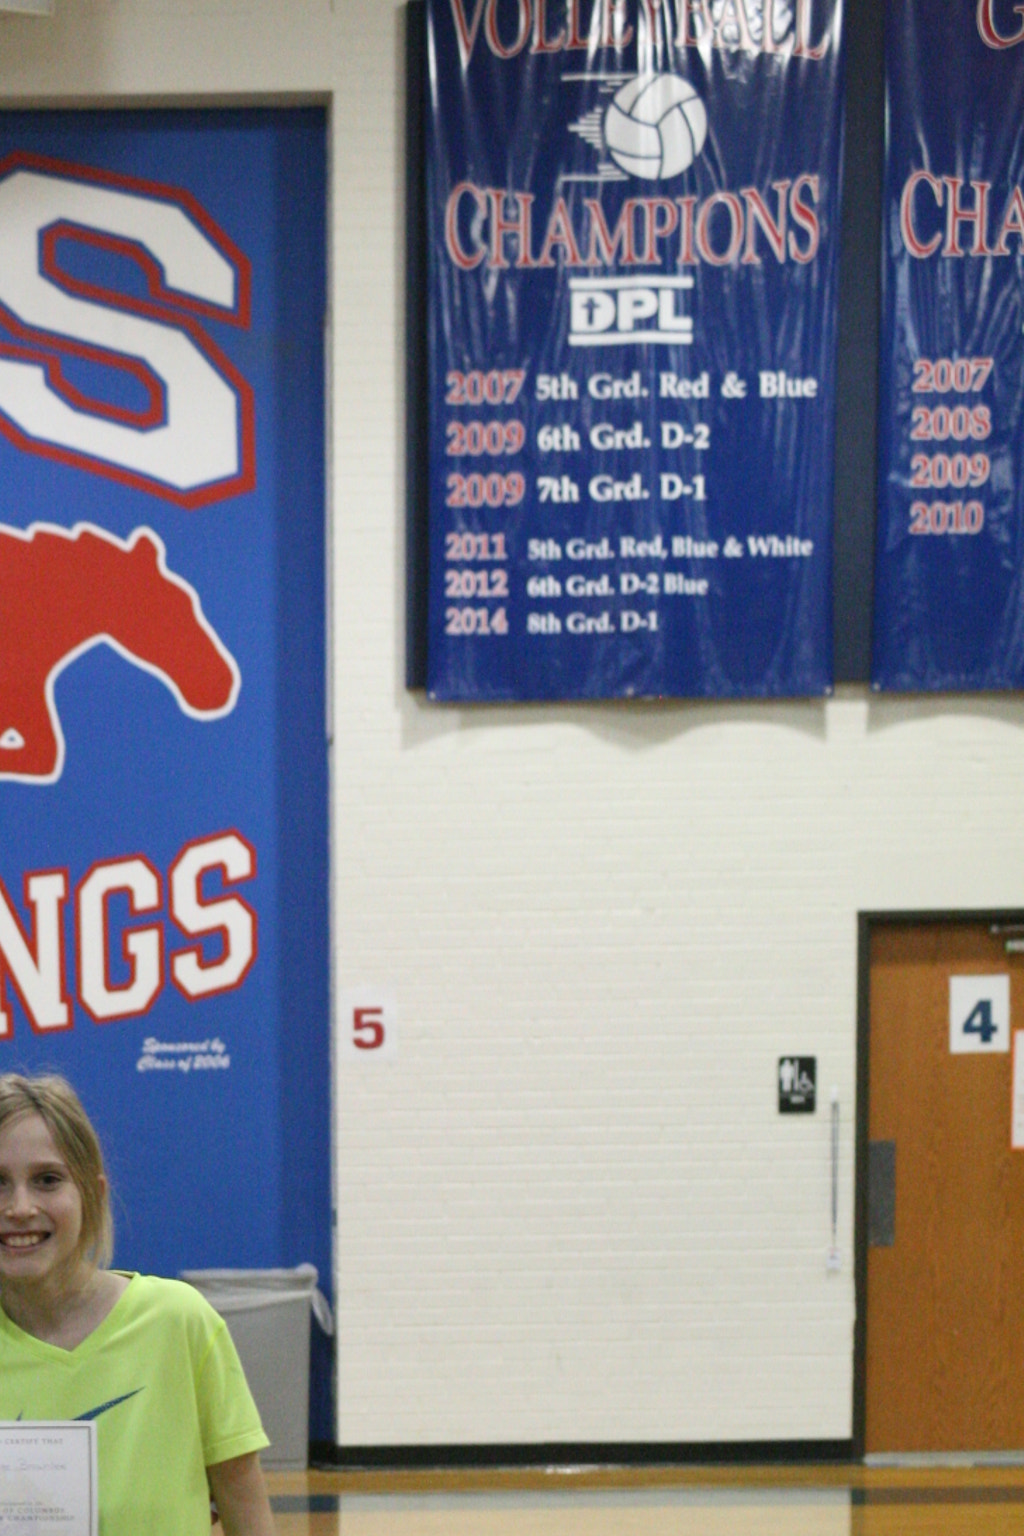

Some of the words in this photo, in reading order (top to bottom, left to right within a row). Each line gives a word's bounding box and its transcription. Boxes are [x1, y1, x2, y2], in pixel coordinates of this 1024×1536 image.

[449, 0, 831, 60] VOLLEYBALL
[445, 174, 820, 270] CHAMPIONS
[570, 288, 694, 333] DPL
[445, 369, 526, 405] 2007
[535, 374, 579, 400] 5th
[587, 372, 649, 400] Grd.
[659, 371, 710, 398] Red
[720, 374, 746, 398] &
[759, 370, 818, 398] Blue
[912, 357, 994, 393] 2007
[446, 420, 525, 456] 2009
[536, 424, 580, 452] 6th
[589, 421, 651, 450] Grd.
[660, 422, 710, 450] D-2
[910, 404, 992, 440] 2008
[910, 453, 991, 488] 2009
[446, 472, 525, 508] 2009
[536, 475, 579, 503] 7th
[588, 474, 650, 502] Grd.
[660, 474, 706, 501] D-1
[909, 500, 984, 534] 2010
[445, 532, 507, 561] 2011
[527, 538, 561, 560] 5th
[566, 537, 615, 561] Grd.
[619, 535, 668, 561] Red,
[672, 535, 719, 558] Blue
[723, 536, 743, 557] &
[747, 534, 814, 558] White
[445, 570, 508, 599] 2012
[527, 575, 561, 598] 6th
[566, 574, 615, 597] Grd.
[619, 573, 660, 595] D-2
[664, 572, 709, 596] Blue
[445, 607, 508, 636] 2014
[527, 612, 561, 635] 8th
[566, 612, 615, 635] Grd.
[620, 611, 659, 632] D-1
[352, 1006, 386, 1050] 5
[962, 998, 998, 1044] 4
